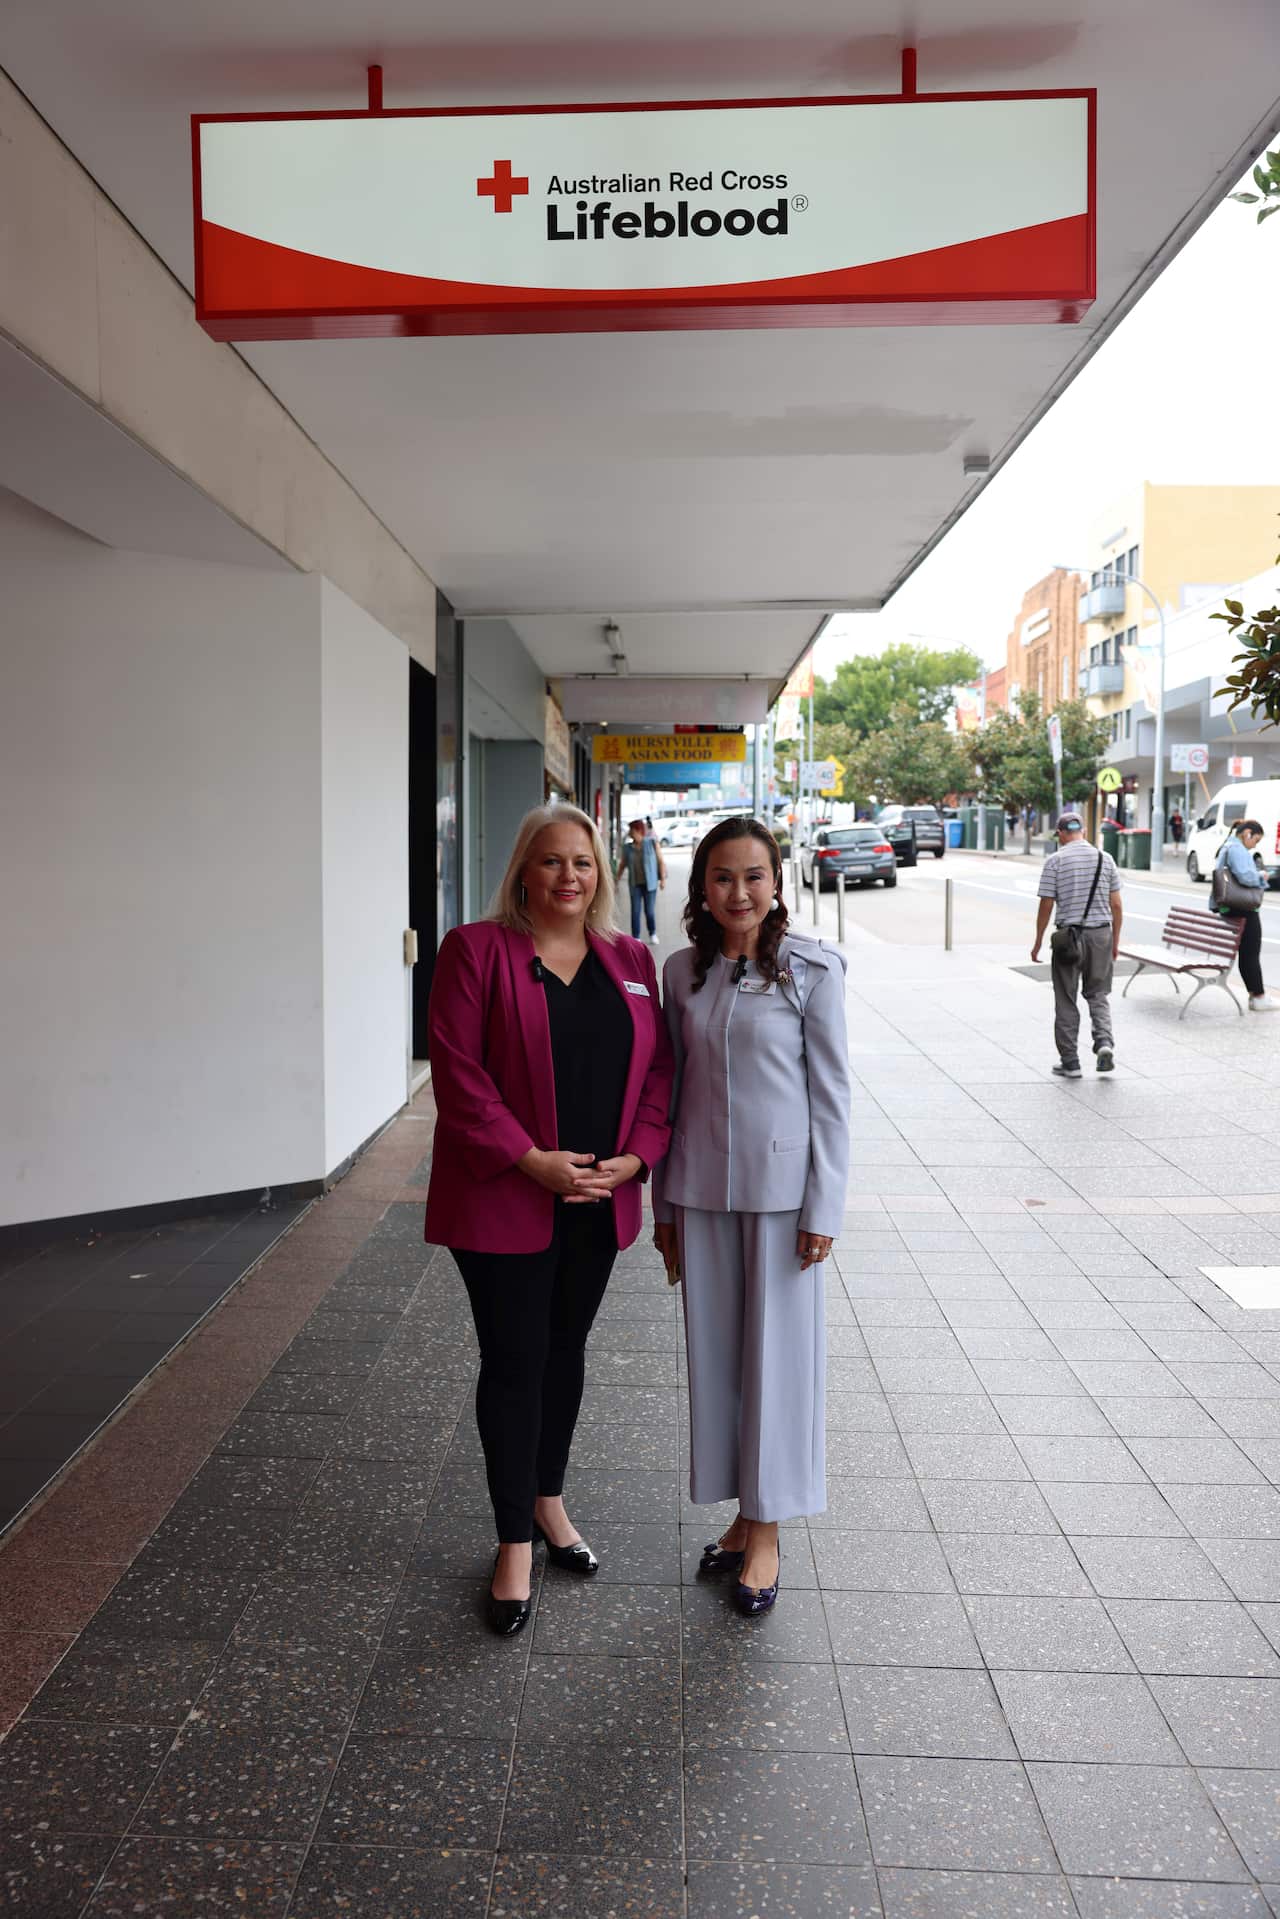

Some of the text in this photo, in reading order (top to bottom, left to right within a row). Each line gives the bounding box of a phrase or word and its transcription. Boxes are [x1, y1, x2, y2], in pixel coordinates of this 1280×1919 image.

[547, 169, 788, 195] Australian Red Cross
[626, 736, 713, 748] HURSTVILLE
[629, 749, 713, 761] ASIAN FOOD
